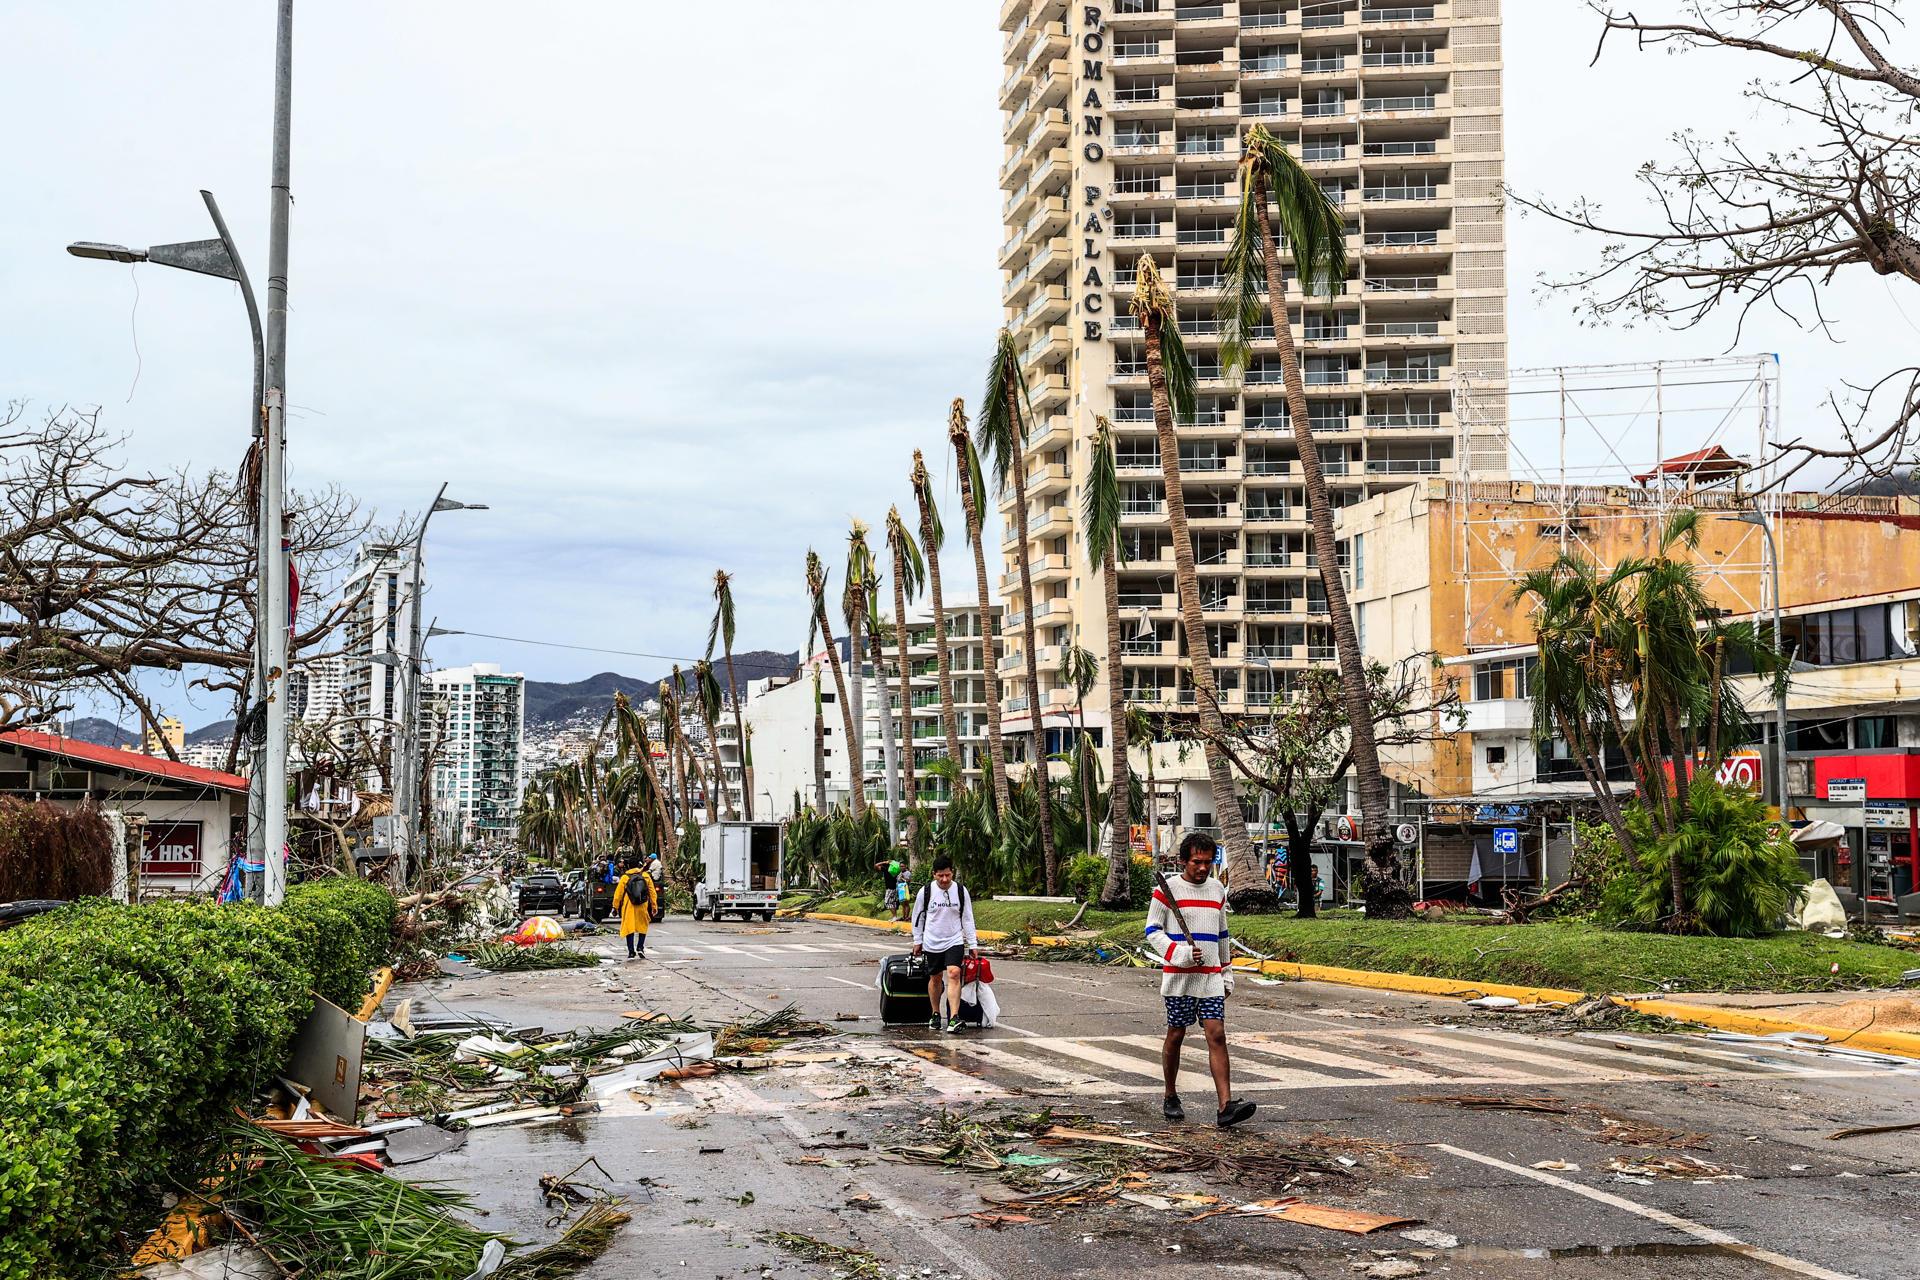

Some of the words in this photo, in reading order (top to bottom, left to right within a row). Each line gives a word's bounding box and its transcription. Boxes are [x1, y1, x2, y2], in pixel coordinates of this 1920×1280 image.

[1083, 6, 1104, 163] ROMANO
[1083, 185, 1103, 341] PALACE
[159, 845, 194, 861] HRS
